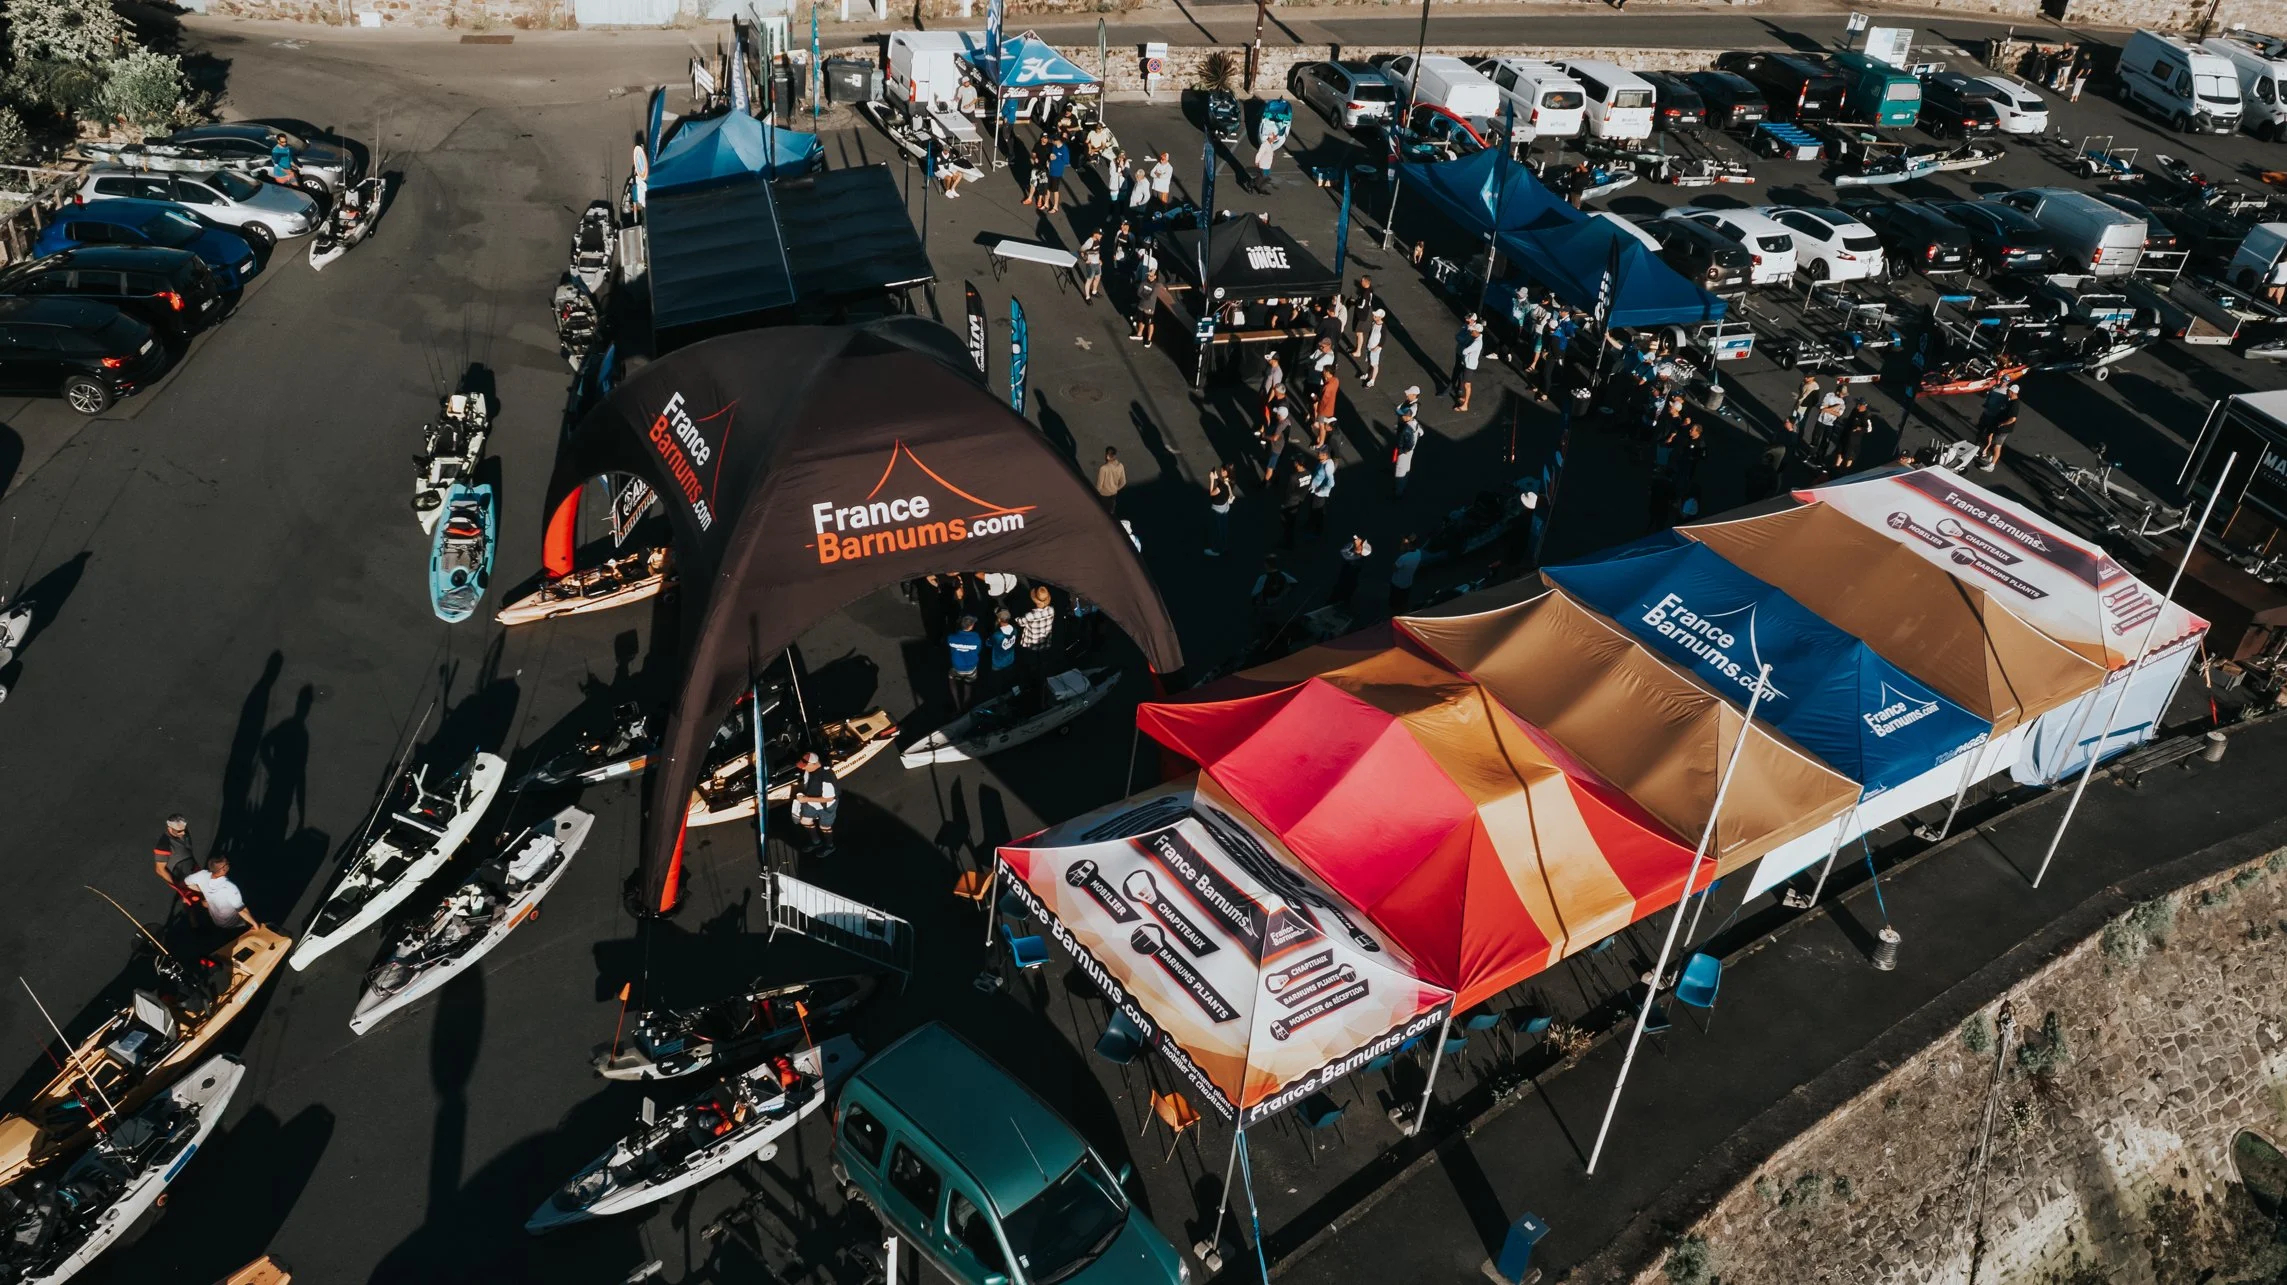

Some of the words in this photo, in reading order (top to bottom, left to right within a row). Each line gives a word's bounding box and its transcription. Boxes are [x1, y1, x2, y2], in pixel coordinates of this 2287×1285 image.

[1247, 252, 1291, 270] UNCLE
[662, 391, 711, 466] France
[649, 414, 713, 532] Barnums.com
[812, 496, 930, 534] France
[817, 513, 1025, 564] Barnums.com
[1908, 524, 1944, 547] MOBILIER
[1965, 534, 2011, 561] CHAPITEAUX
[1975, 560, 2010, 582] BARNUMS
[2009, 578, 2041, 598] PLIANTS
[1656, 592, 1735, 649] France
[1642, 604, 1777, 702] Barnums.com
[1862, 701, 1908, 727] France
[1872, 704, 1940, 737] Barnums.com
[1090, 879, 1128, 917] MOBILIER
[1157, 902, 1206, 950] CHAPITEAUX
[998, 858, 1152, 1038] France-Barnums.com
[1290, 955, 1329, 976] CHAPITEAUX
[1159, 949, 1196, 984] BARNUMS
[1192, 981, 1229, 1019] PLIANTS
[1283, 984, 1317, 1005] BARNUMS
[1317, 973, 1341, 989] PLIANTS
[1289, 1004, 1325, 1027] MOBILIER
[1324, 999, 1333, 1009] de
[1333, 985, 1365, 1006] RÉCEPTION
[1161, 1045, 1190, 1075] mobilier
[1188, 1073, 1197, 1083] et
[1164, 1035, 1181, 1055] Vente
[1180, 1053, 1189, 1064] de
[1187, 1060, 1213, 1091] barnums
[1249, 1009, 1442, 1122] France-Barnums.com
